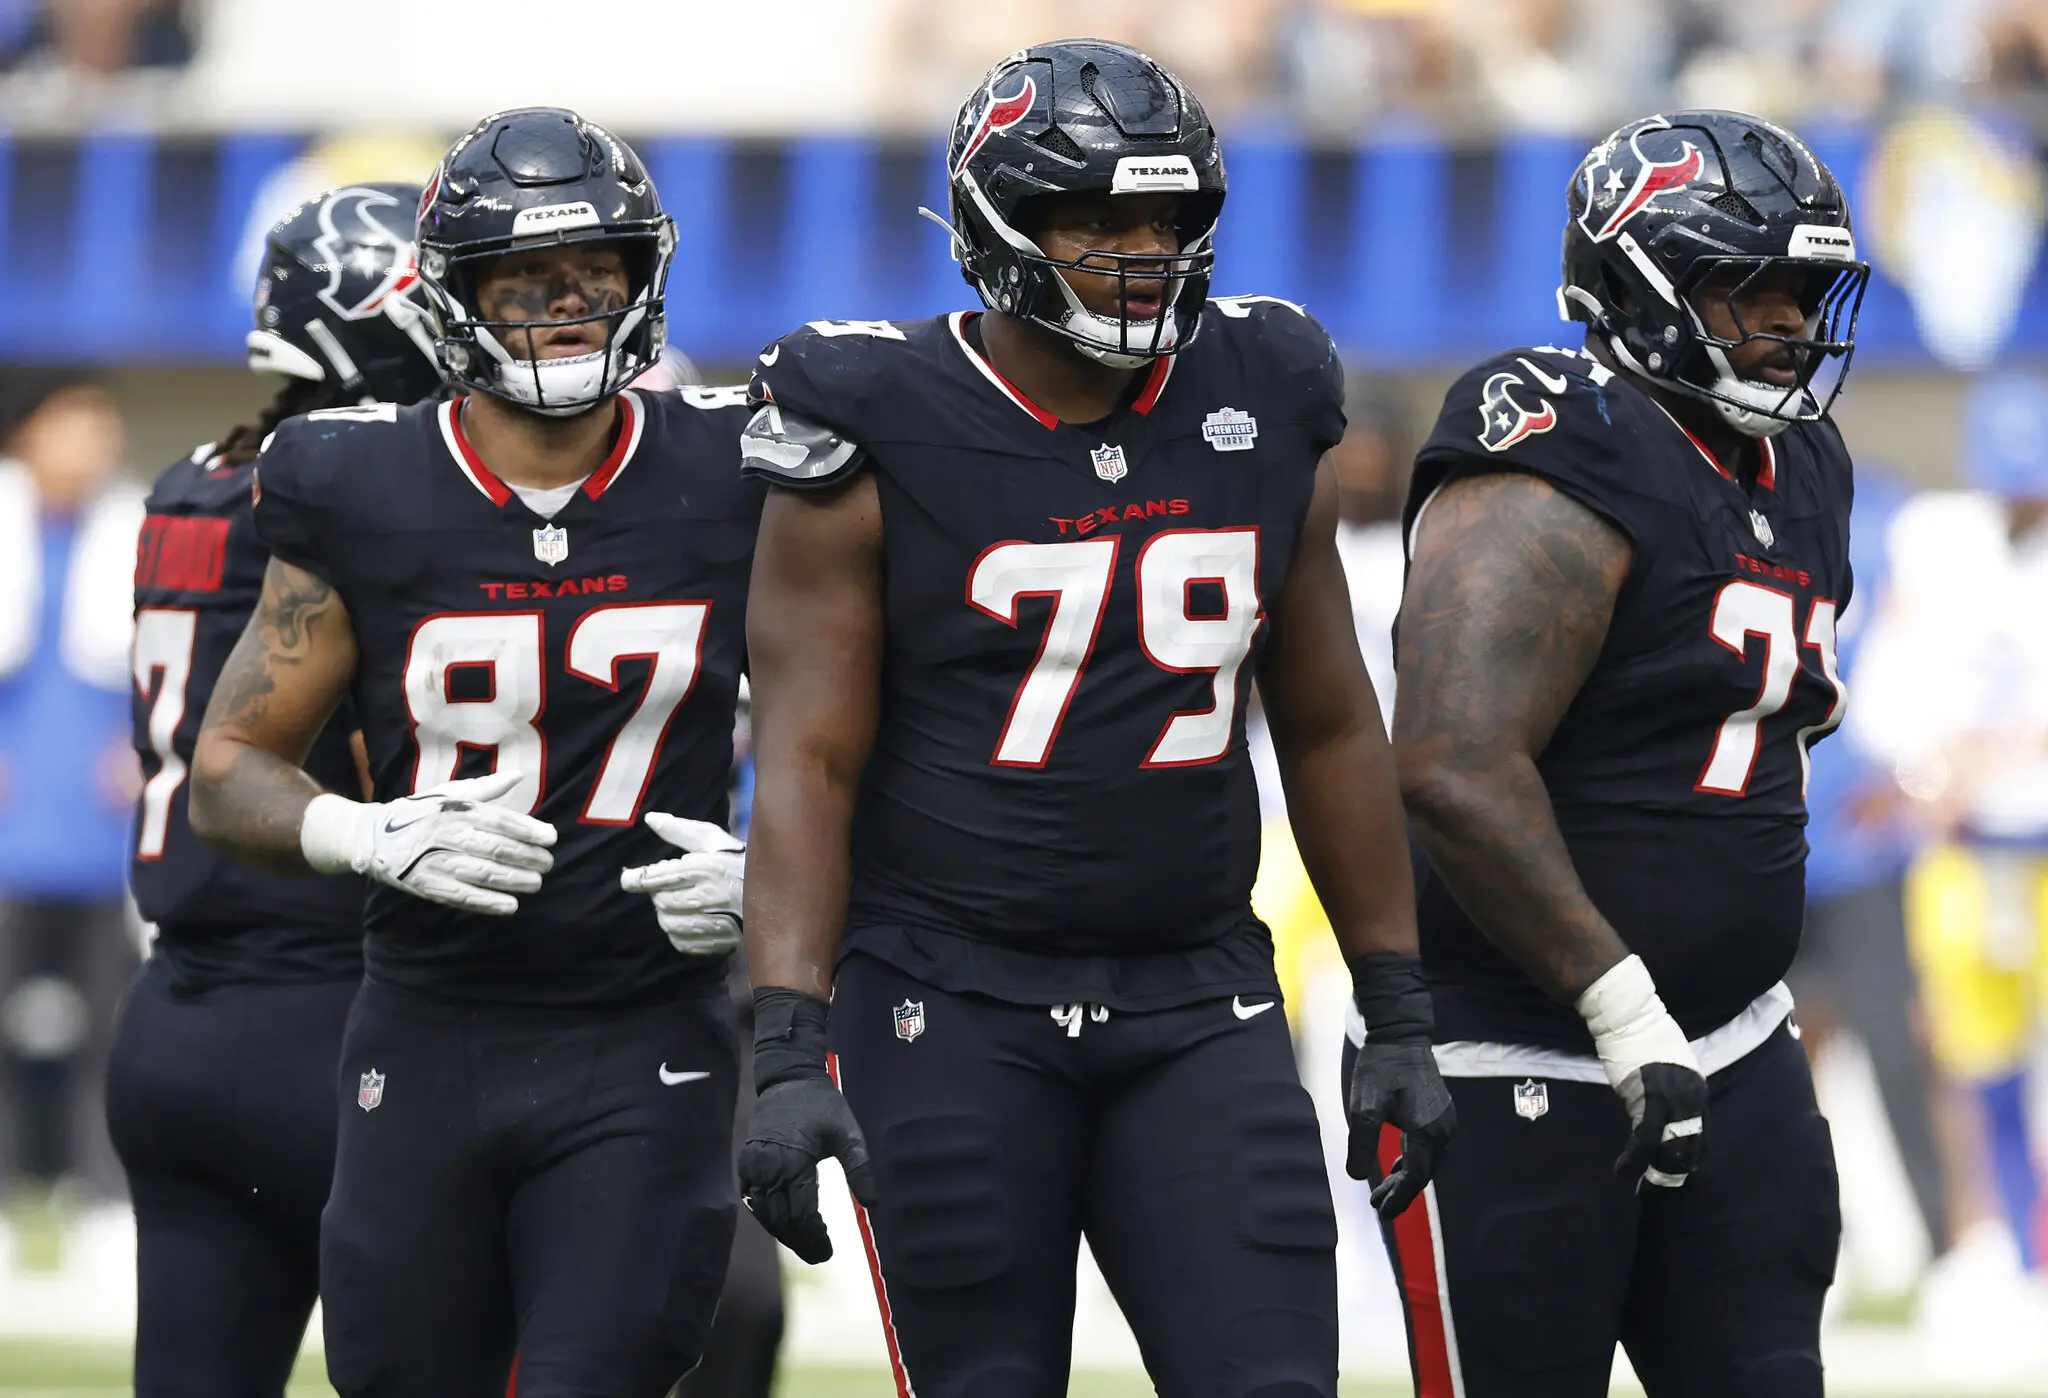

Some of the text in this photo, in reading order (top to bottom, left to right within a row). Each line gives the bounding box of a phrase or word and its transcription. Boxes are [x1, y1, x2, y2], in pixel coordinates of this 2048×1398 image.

[1127, 167, 1190, 176] TEXANS
[522, 206, 589, 221] TEXANS
[1805, 235, 1851, 247] TEXANS
[1100, 460, 1122, 476] NFL
[1048, 498, 1192, 536] TEXANS
[1734, 552, 1811, 588] TEXANS
[479, 573, 629, 600] TEXANS
[965, 525, 1267, 769] 79
[1693, 578, 1848, 802] 71
[401, 599, 714, 826] 87
[133, 604, 199, 861] 7
[898, 1017, 921, 1036] NFL
